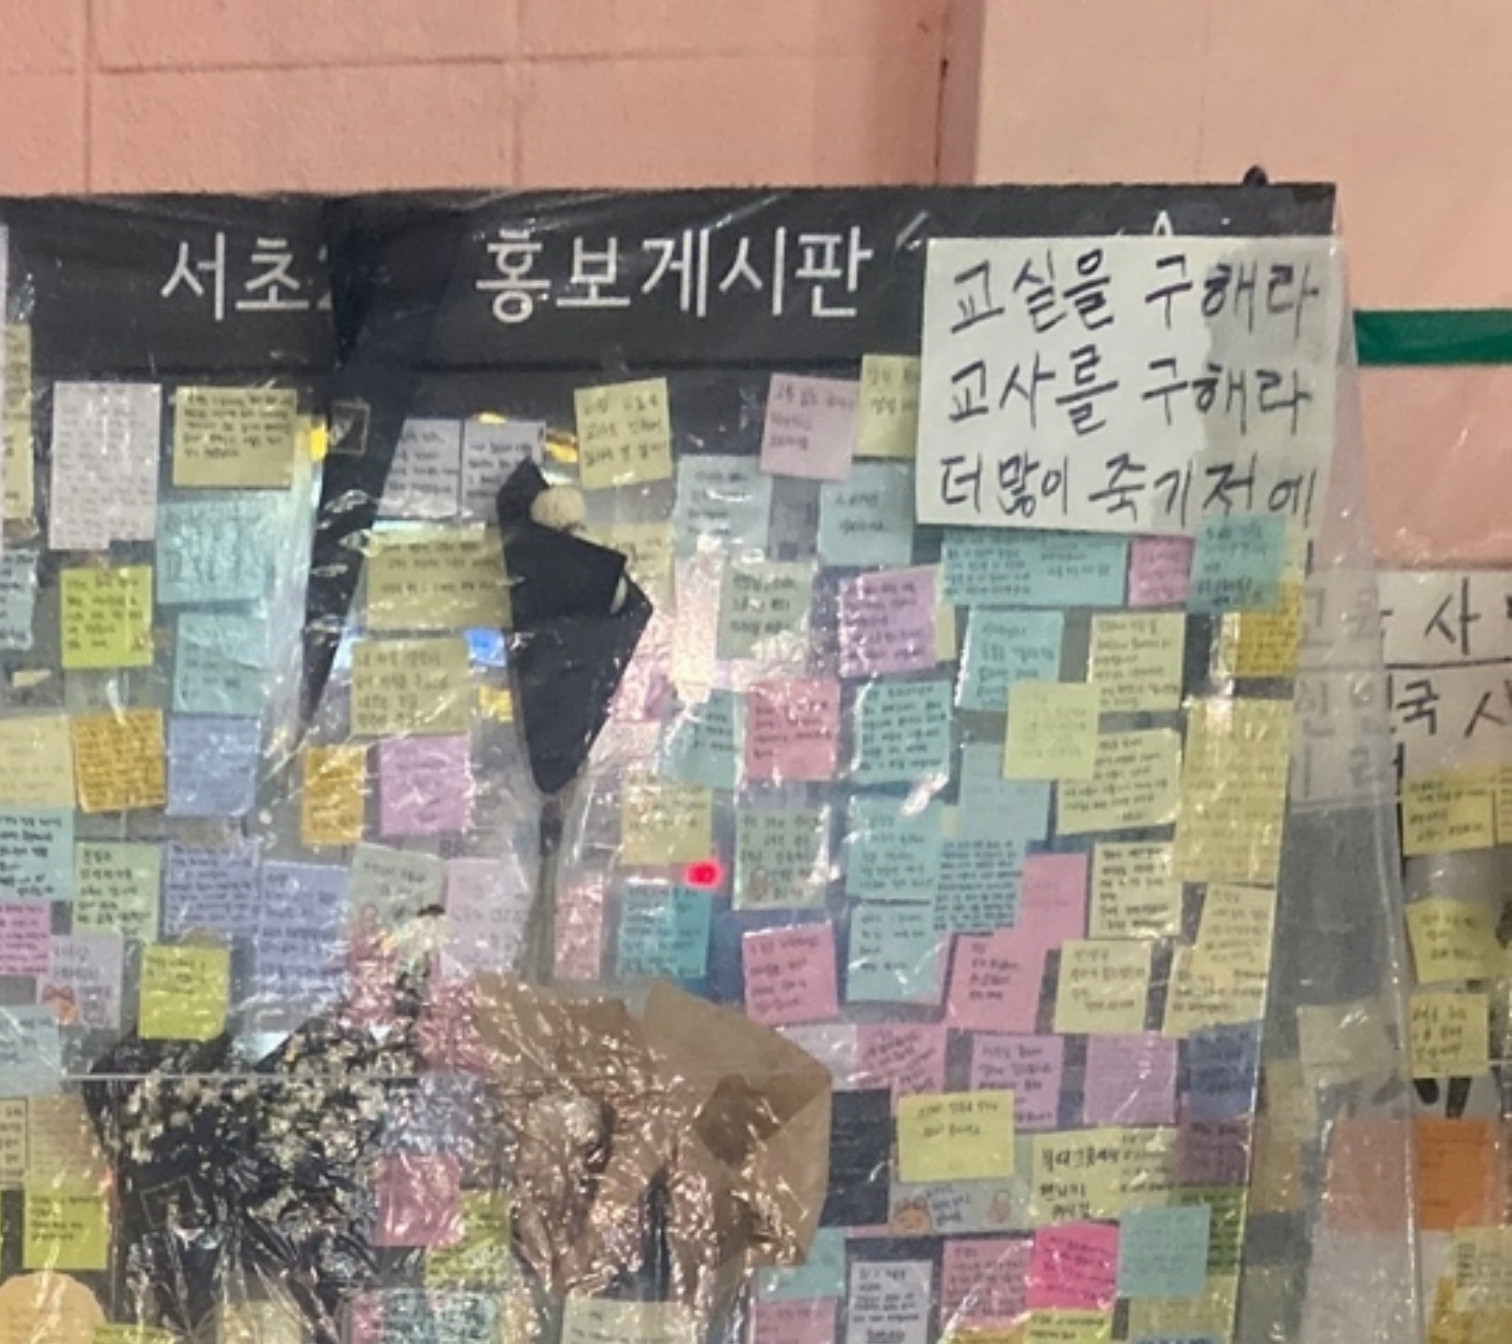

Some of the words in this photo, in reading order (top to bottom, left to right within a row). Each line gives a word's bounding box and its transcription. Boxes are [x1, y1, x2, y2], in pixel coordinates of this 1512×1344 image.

[161, 230, 331, 321] 서초
[476, 225, 875, 324] 홍보게시판
[951, 248, 1115, 335] 교실을
[1145, 254, 1319, 339] 구해라
[948, 344, 1118, 436] 교사를
[1142, 358, 1314, 434] 구해라
